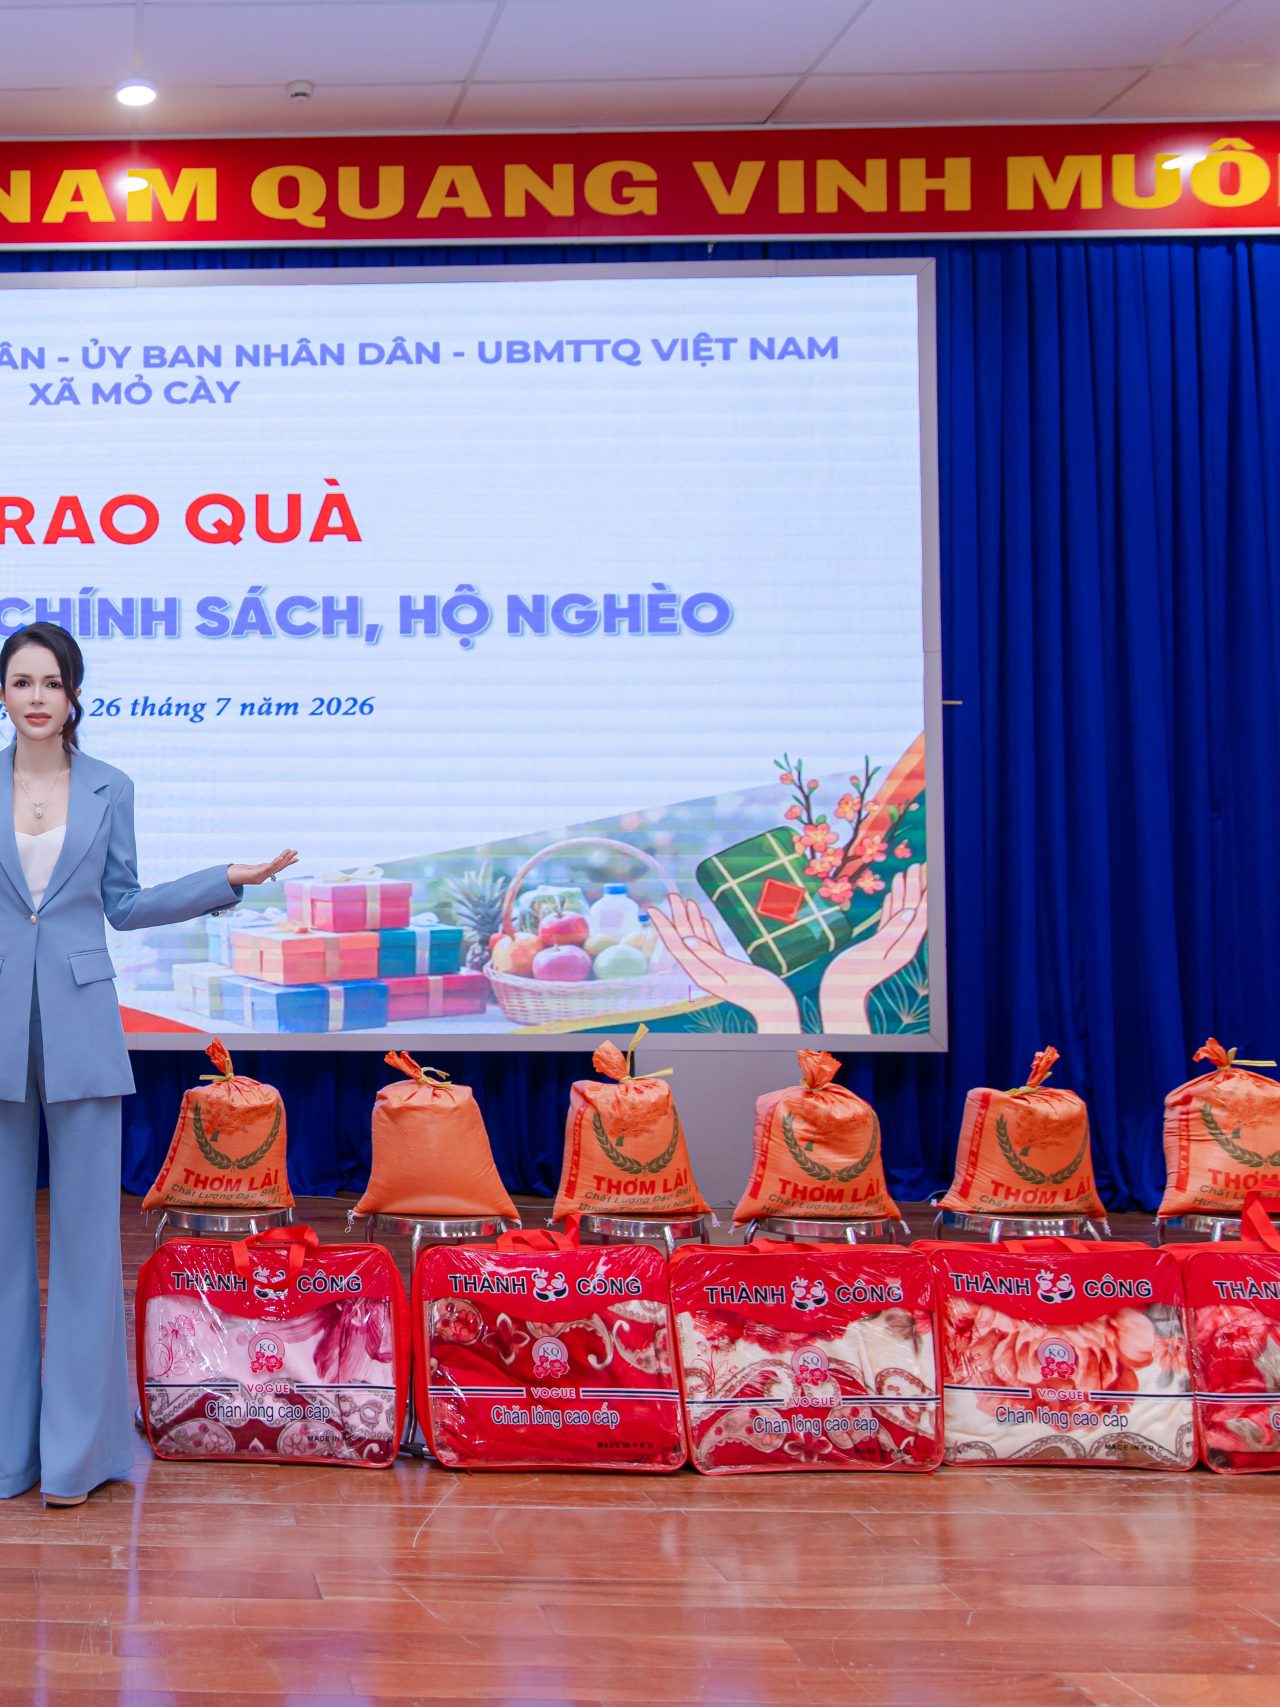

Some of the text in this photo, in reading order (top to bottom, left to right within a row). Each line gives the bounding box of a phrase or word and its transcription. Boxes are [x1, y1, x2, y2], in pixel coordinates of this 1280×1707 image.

[249, 160, 659, 229] QUANG
[692, 156, 972, 214] VINH
[1006, 137, 1280, 210] MUÔ
[81, 344, 131, 371] ỦY
[142, 341, 222, 370] BAN
[233, 337, 345, 368] NHÂN
[358, 336, 441, 366] DÂN
[477, 338, 642, 367] UBMTTQ
[651, 331, 738, 369] VIỆT
[749, 335, 839, 361] NAM
[29, 374, 241, 406] XÃ MỎ CÀY
[185, 478, 362, 545] QUÀ
[195, 586, 382, 645] SÁCH,
[399, 583, 493, 650] HỘ
[507, 583, 734, 638] NGHÈO
[88, 697, 122, 717] 26
[130, 696, 207, 723] tháng
[215, 697, 232, 716] 7
[240, 696, 299, 716] năm
[309, 696, 376, 716] 2026
[1208, 1167, 1279, 1190] THƠ
[171, 1270, 362, 1293] THÀNH CÔNG
[448, 1272, 642, 1295] THÀNH CÔNG
[704, 1280, 903, 1304] THÀNH CÔNG
[949, 1271, 1153, 1298] THÀNH CÔNG
[1214, 1277, 1280, 1300] THÀN
[260, 1343, 276, 1353] KQ
[543, 1347, 560, 1357] KQ
[1049, 1349, 1066, 1358] KQ
[803, 1356, 820, 1366] KQ
[247, 1383, 290, 1394] VOGUE
[530, 1387, 576, 1398] VOGUE
[1038, 1389, 1084, 1401] VOGUE
[206, 1398, 331, 1422] Chăn lông cao cấp
[792, 1397, 836, 1408] VOGUE
[492, 1402, 620, 1429] Chăn lông cao cấp
[753, 1412, 879, 1436] Chăn lông cao cấp
[995, 1404, 1129, 1431] Chăn lông cao cấp
